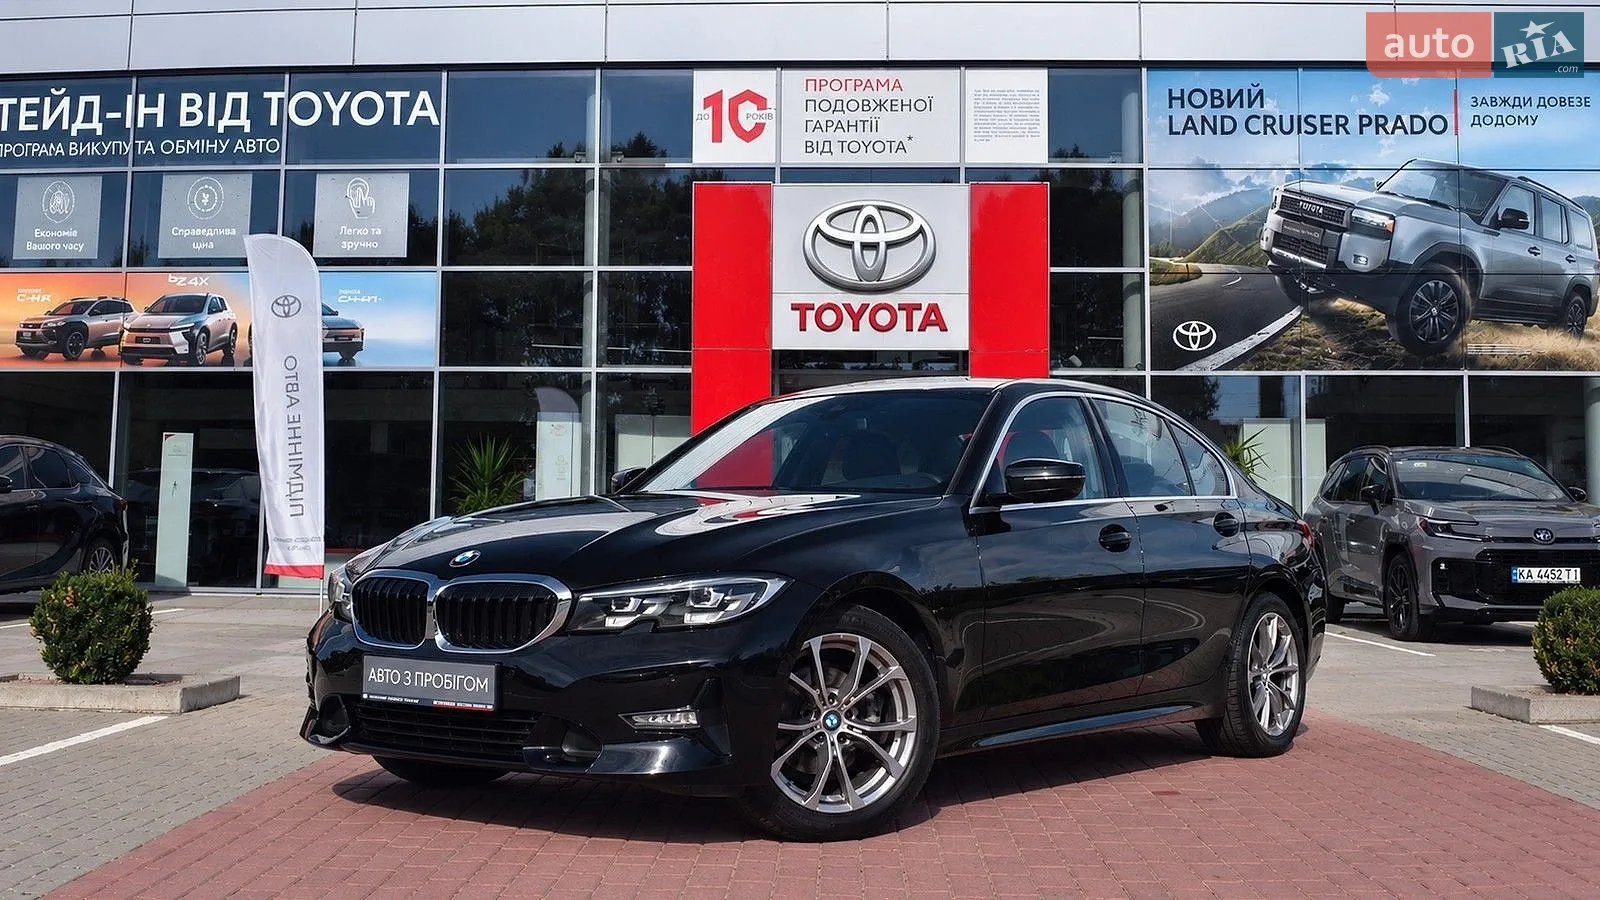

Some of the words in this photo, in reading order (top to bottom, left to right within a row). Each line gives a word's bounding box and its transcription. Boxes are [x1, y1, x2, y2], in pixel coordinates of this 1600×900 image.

[805, 78, 903, 92] ПРОГРАМА
[805, 96, 934, 114] ПОДОВЖЕНОЇ
[1168, 83, 1265, 109] НОВИЙ
[1470, 96, 1533, 109] ЗАВЖДИ
[1536, 96, 1591, 109] ДОВЕЗЕ
[179, 91, 251, 133] ВІД
[263, 90, 440, 126] TOYOTA
[696, 113, 710, 121] ДО
[746, 112, 774, 121] РОКІВ
[805, 116, 880, 133] ГАРАНТІЇ
[1168, 115, 1237, 136] LAND
[1244, 115, 1351, 136] CRUISER
[1358, 115, 1448, 136] PRADO
[1470, 115, 1539, 128] ДОДОМУ
[69, 141, 132, 156] ВИКУПУ
[135, 140, 155, 154] ТА
[160, 139, 230, 154] ОБМІНУ
[233, 138, 280, 153] АВТО
[805, 140, 833, 155] ВІД
[790, 302, 949, 333] TOYOTA
[368, 667, 401, 685] АВТО
[403, 670, 412, 686] З
[414, 671, 489, 693] ПРОБІГОМ
